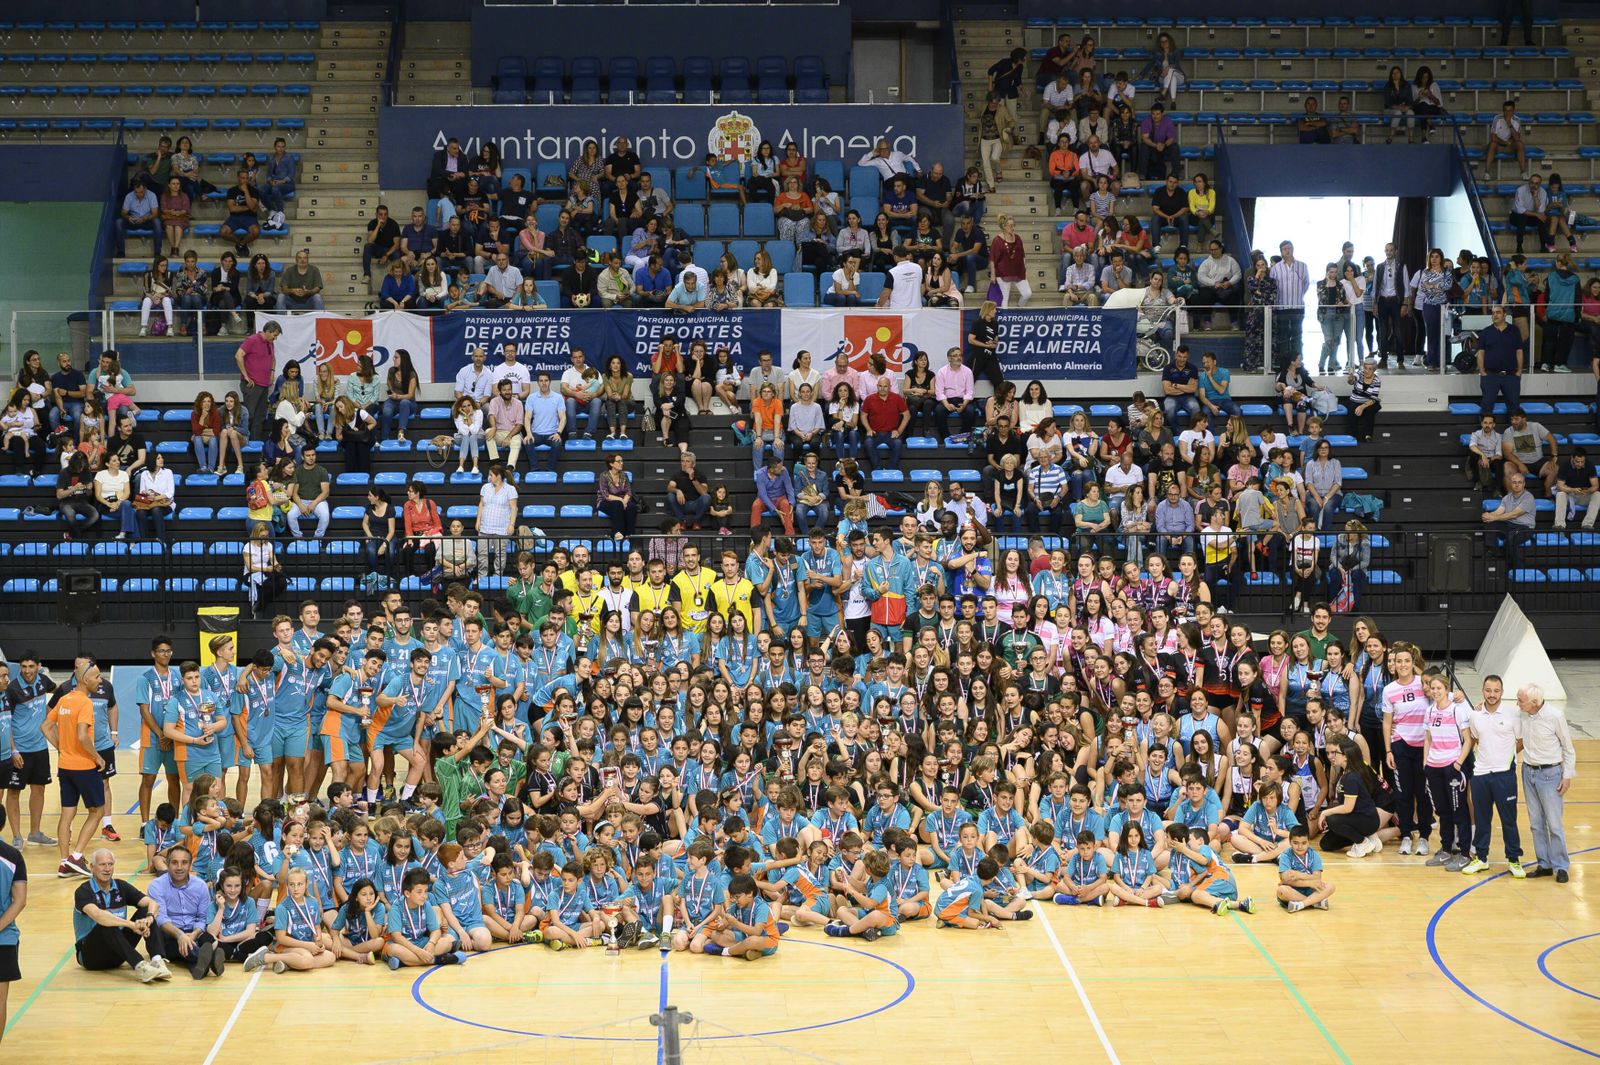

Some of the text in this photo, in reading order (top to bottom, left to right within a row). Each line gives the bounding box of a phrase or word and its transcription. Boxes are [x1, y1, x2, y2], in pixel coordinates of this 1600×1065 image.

[515, 316, 557, 324] MUNICIPAL
[637, 315, 685, 324] PATRONATO
[686, 315, 730, 324] MUNICIPAL
[1046, 314, 1089, 322] MUNICIPAL
[464, 325, 571, 340] DEPORTES
[635, 324, 743, 339] DEPORTES
[997, 324, 1102, 337] DEPORTES
[984, 326, 994, 355] NIE
[493, 341, 571, 356] AMERIA
[635, 341, 660, 355] DE
[995, 340, 1101, 354] DE ALMERIA
[1064, 361, 1103, 371] Almería
[398, 648, 409, 660] 21
[1402, 692, 1415, 703] 18
[1432, 717, 1442, 727] 15
